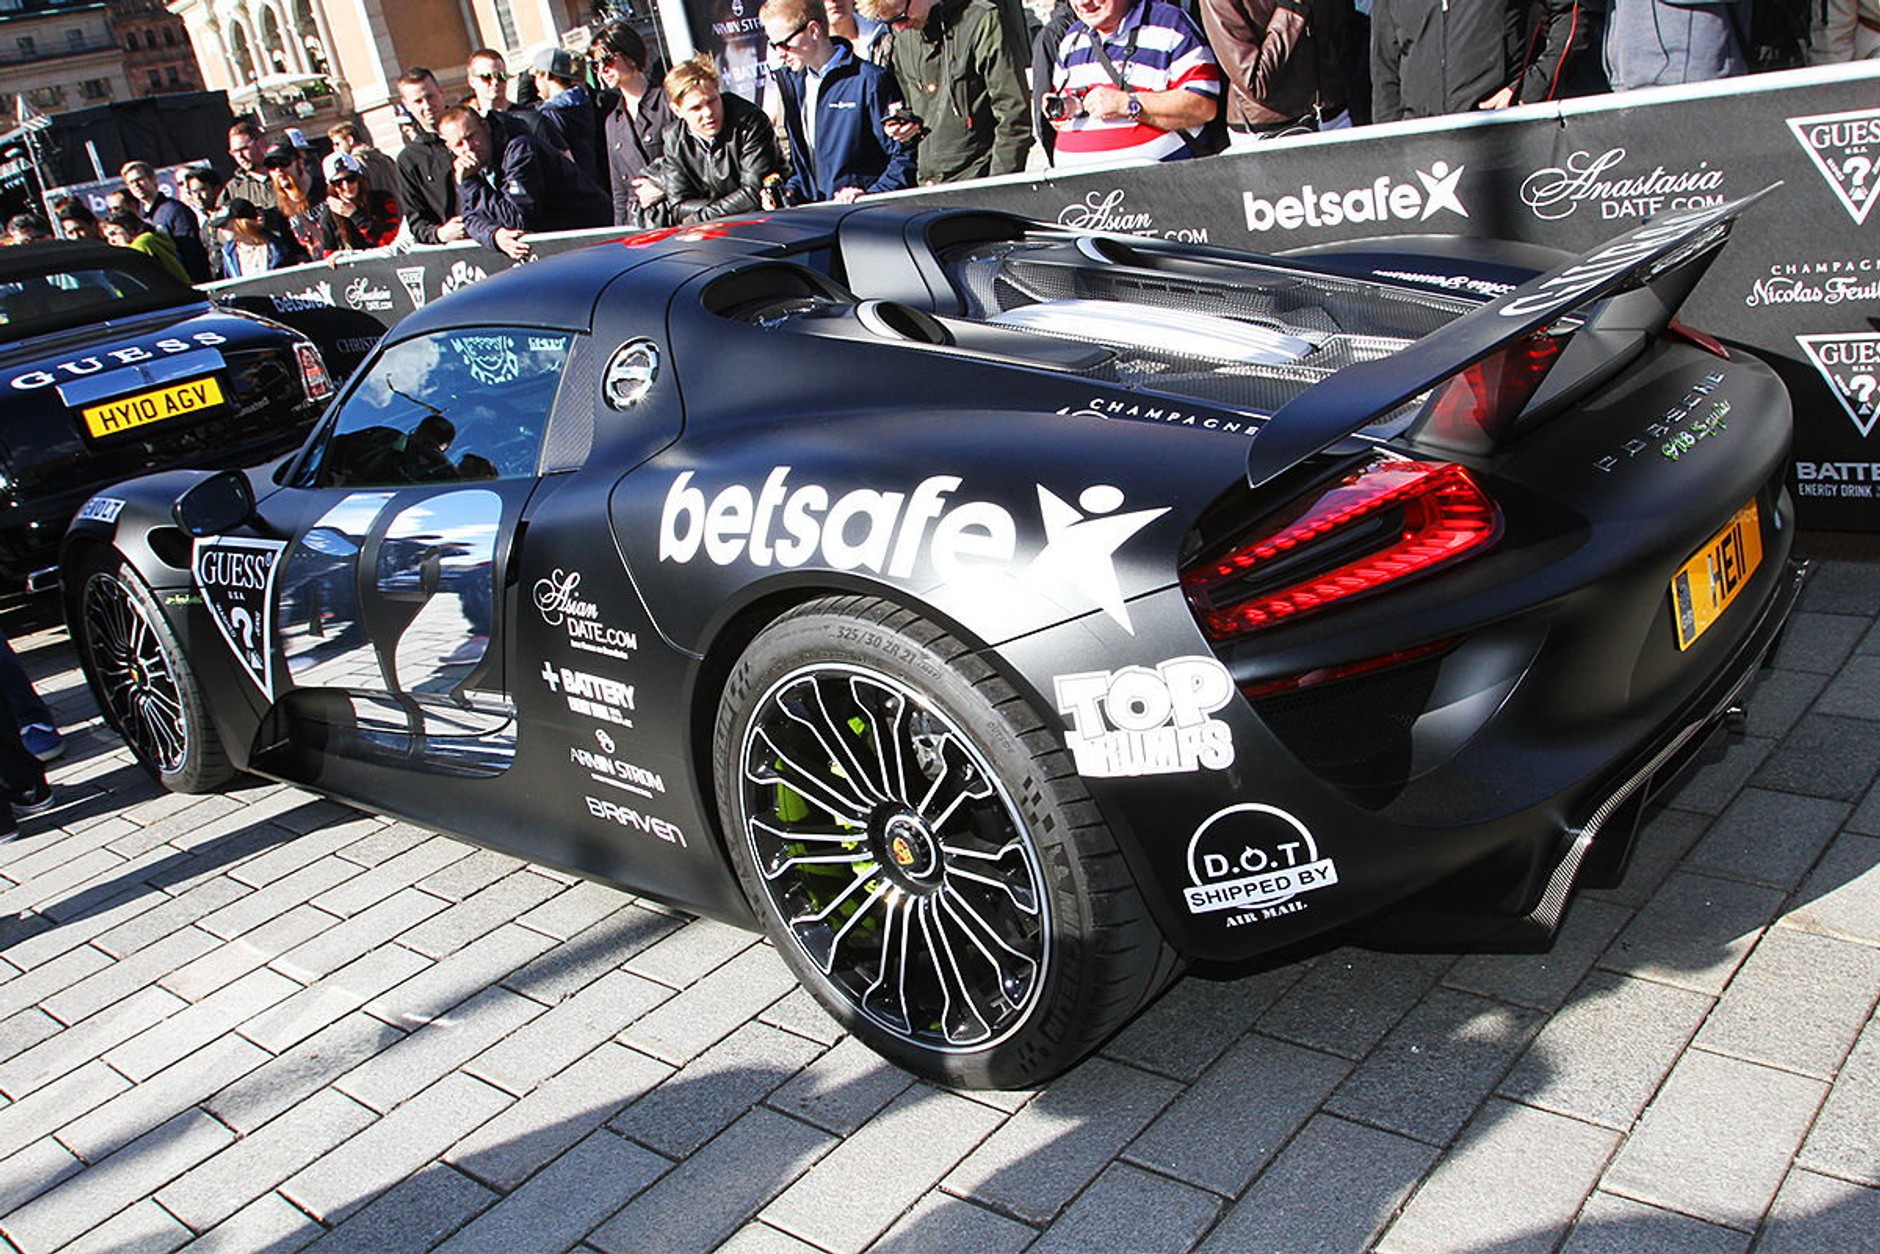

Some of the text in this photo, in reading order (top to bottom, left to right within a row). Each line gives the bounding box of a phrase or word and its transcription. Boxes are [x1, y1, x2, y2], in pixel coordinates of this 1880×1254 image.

[1243, 175, 1422, 232] betsafe
[1520, 147, 1725, 219] Anastasia
[1058, 189, 1153, 230] Asian
[1601, 195, 1724, 219] DATECOM
[1746, 278, 1823, 306] Nicolas
[11, 331, 227, 390] GUESS
[99, 399, 158, 431] HY10
[164, 384, 208, 415] AGV
[1089, 398, 1260, 436] CHAMPAGNE
[1799, 483, 1873, 498] ENERGY DRINK
[659, 465, 1017, 580] betsafe
[200, 551, 266, 591] GUESS
[533, 568, 600, 626] Asian
[567, 617, 637, 650] DATE.COM
[837, 625, 882, 649] 325/30
[560, 668, 635, 709] BATTERY
[1053, 655, 1236, 741] TOP
[1190, 865, 1330, 908] SHIPPED BY
[1225, 912, 1259, 928] AIR
